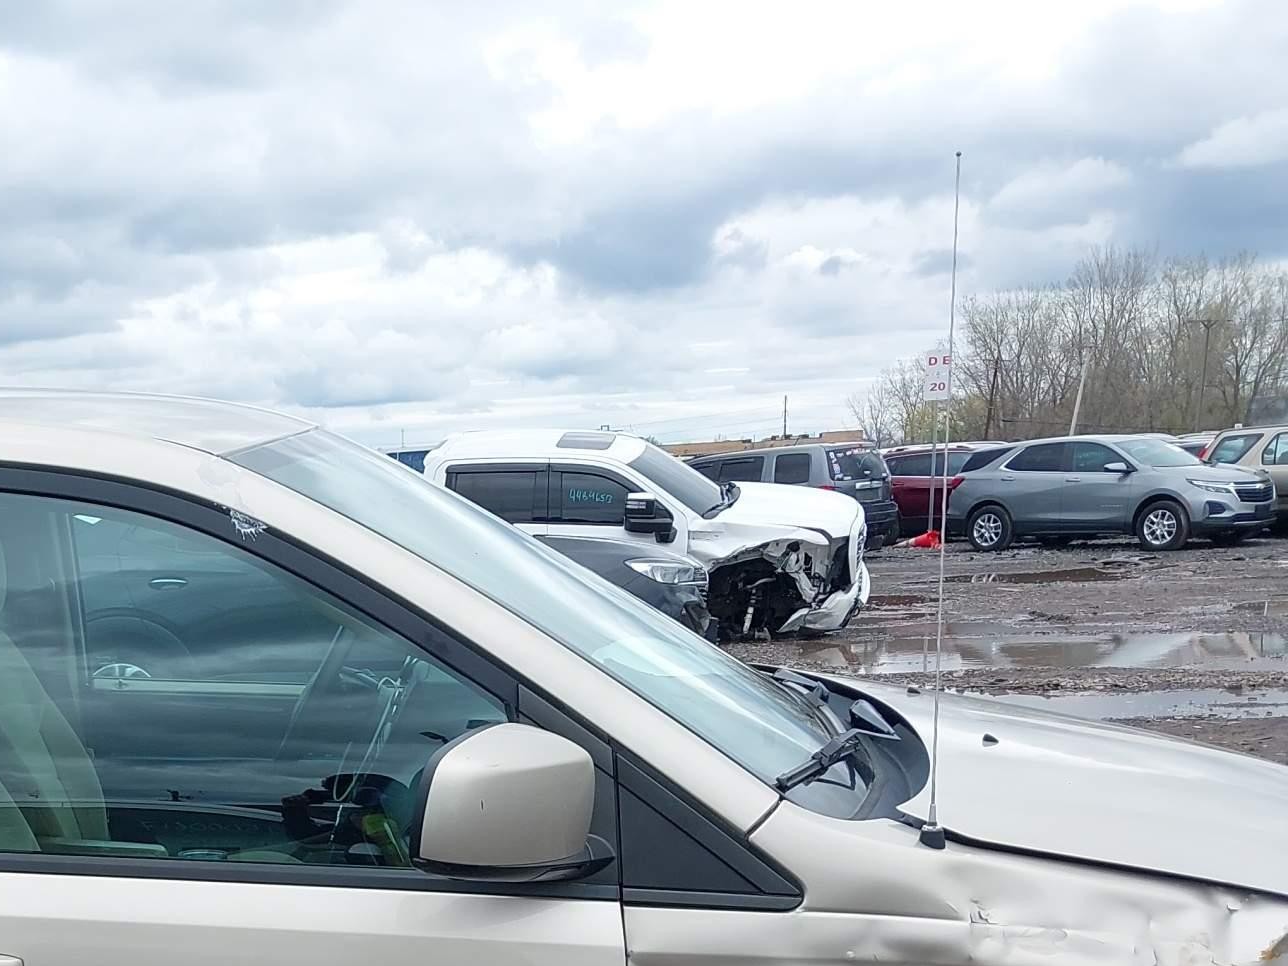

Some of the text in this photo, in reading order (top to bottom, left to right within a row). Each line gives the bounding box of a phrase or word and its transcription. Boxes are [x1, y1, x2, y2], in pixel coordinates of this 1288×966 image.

[928, 355, 953, 366] D E
[929, 382, 946, 392] 20
